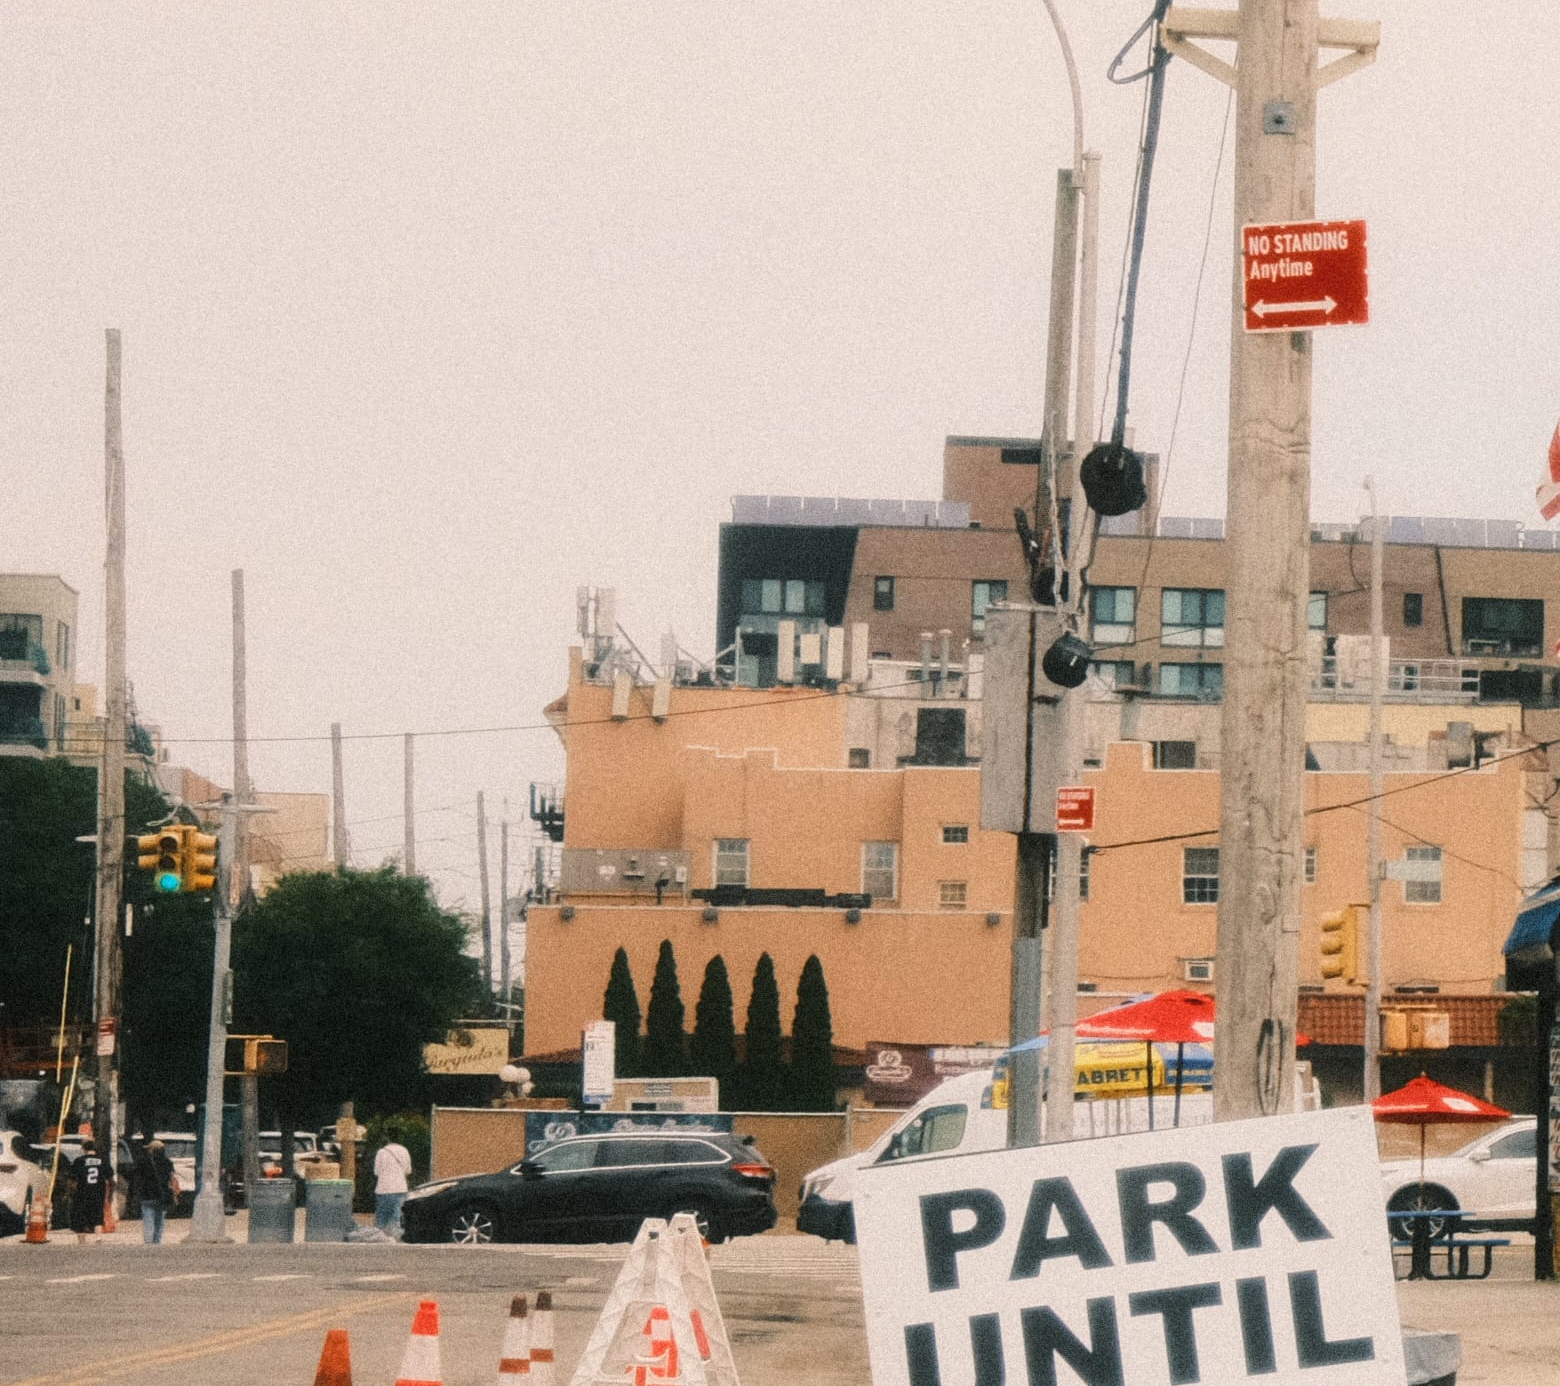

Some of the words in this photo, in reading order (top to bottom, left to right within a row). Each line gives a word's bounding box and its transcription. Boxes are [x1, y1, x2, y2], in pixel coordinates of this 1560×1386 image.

[1248, 235, 1270, 256] NO
[1274, 230, 1349, 254] STANDING
[1249, 258, 1314, 283] Anytime
[87, 1167, 99, 1185] 2
[918, 1143, 1335, 1293] PARK
